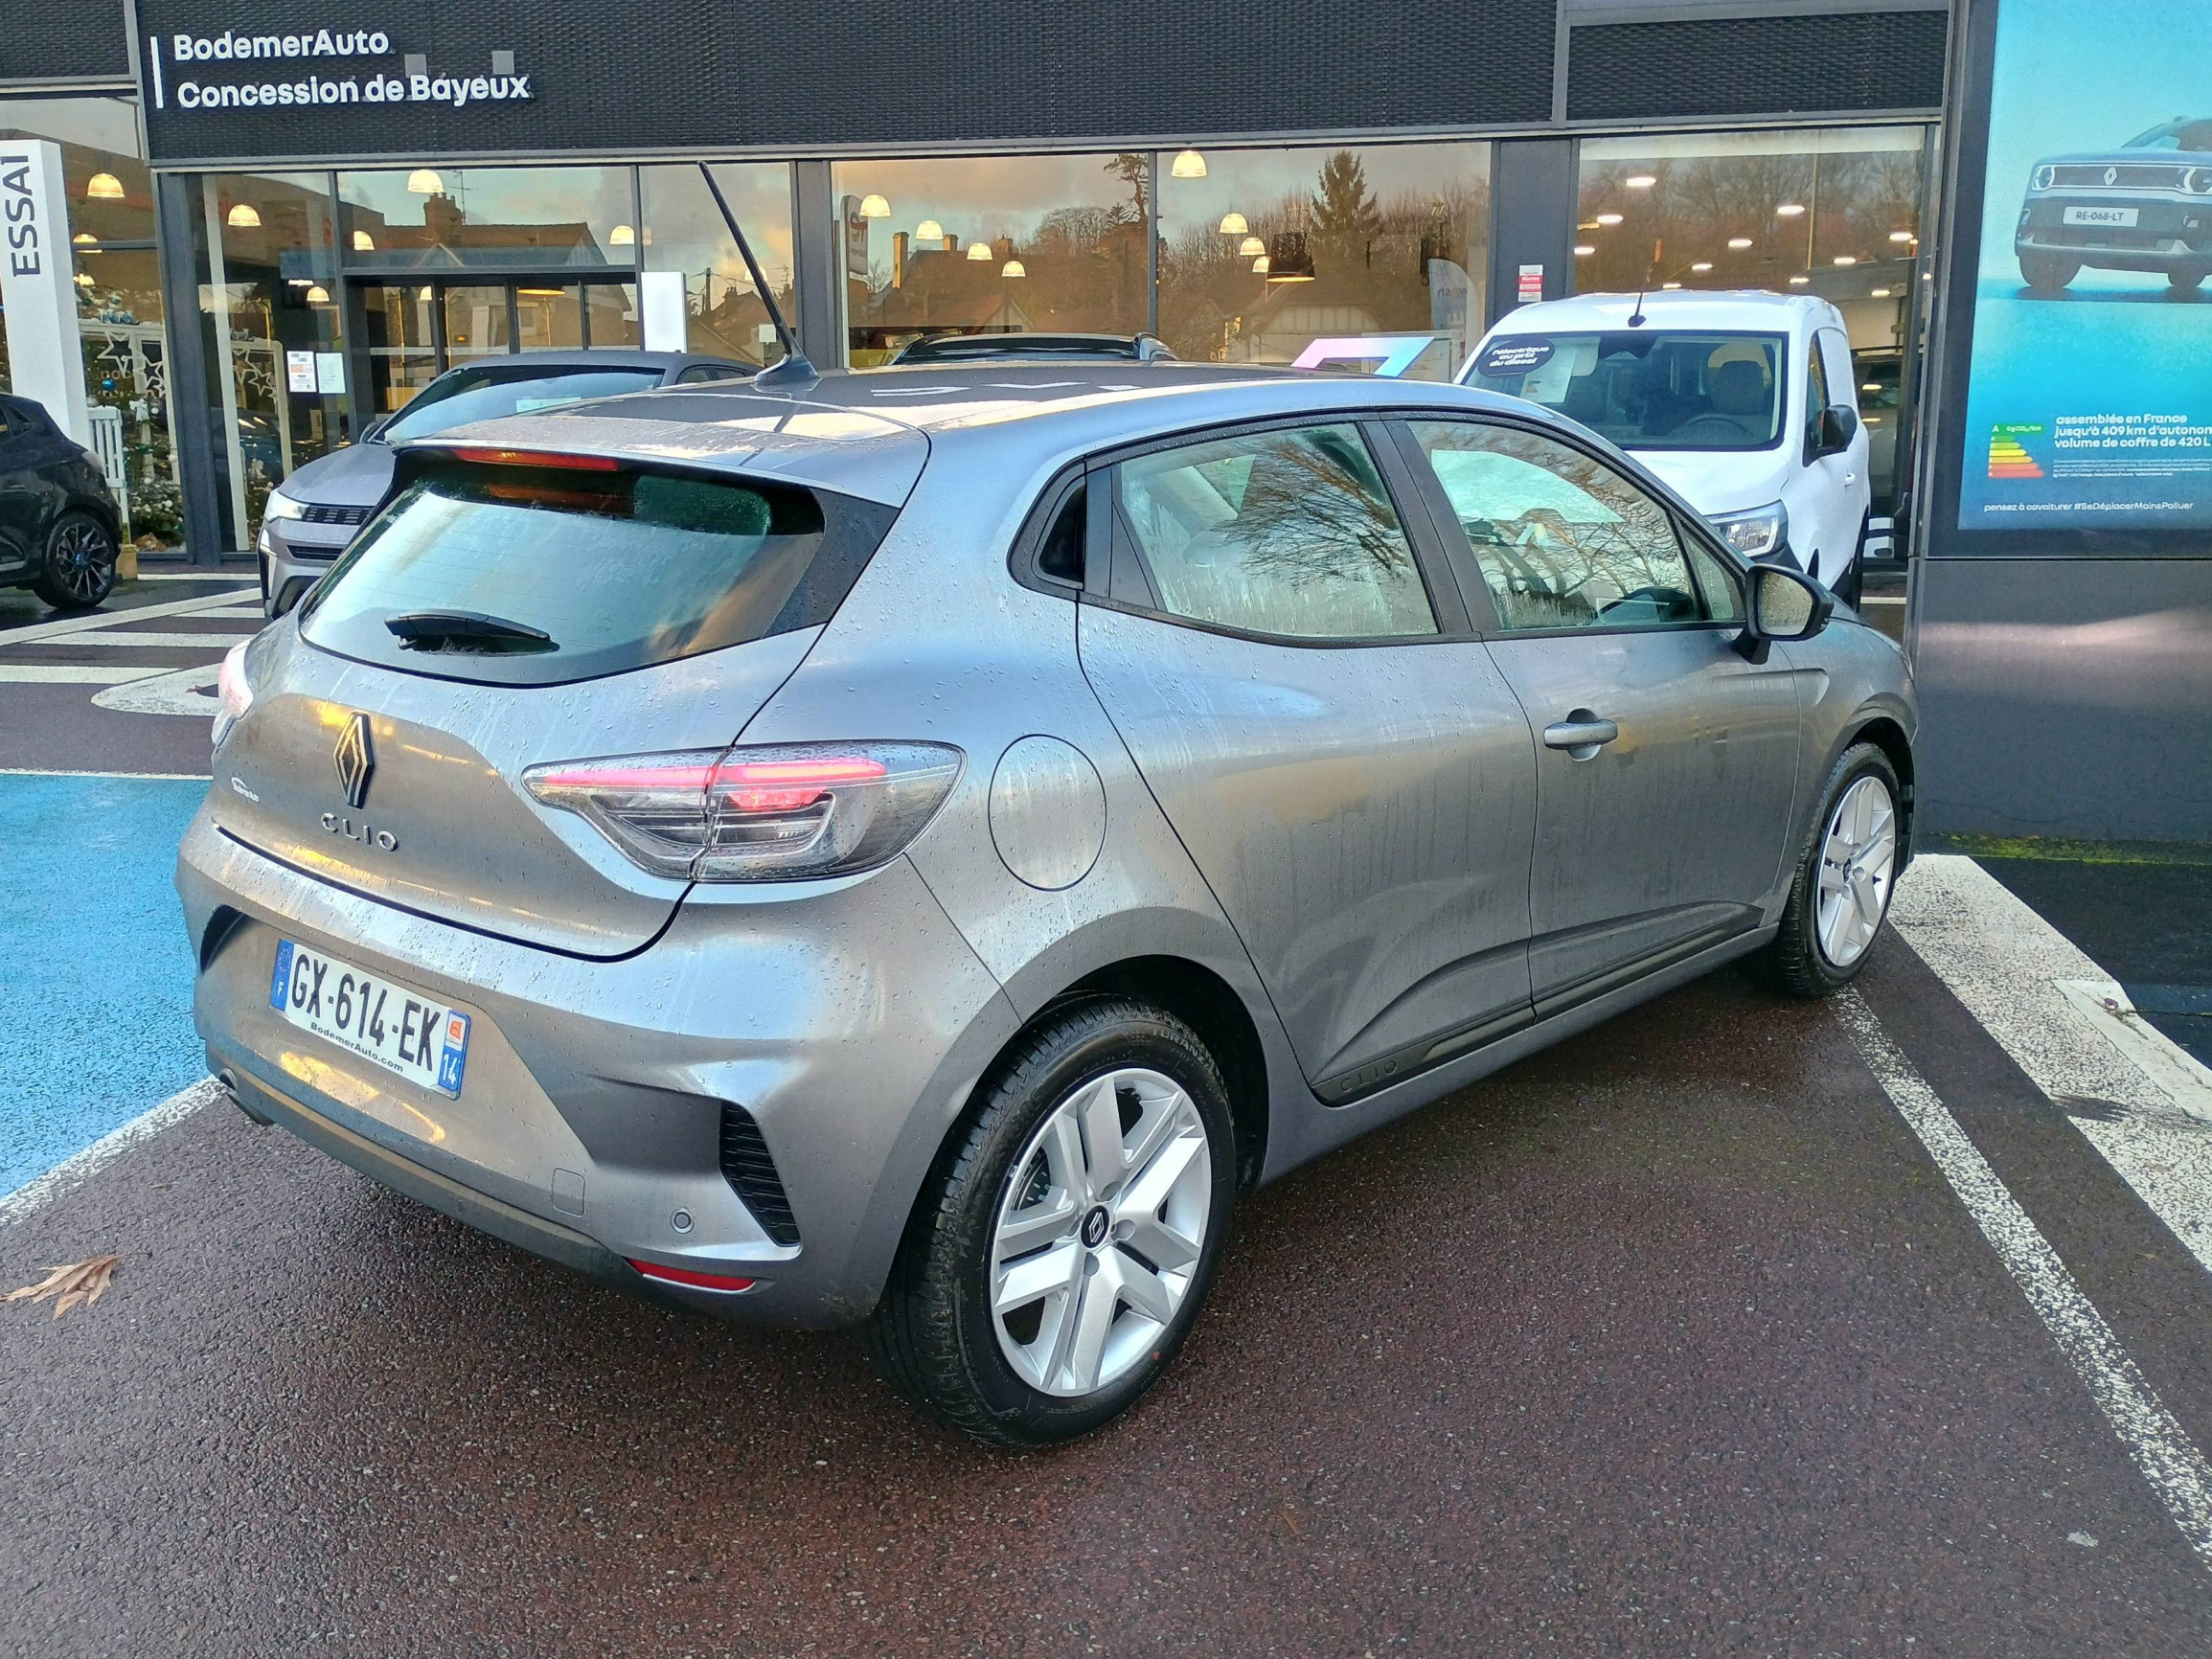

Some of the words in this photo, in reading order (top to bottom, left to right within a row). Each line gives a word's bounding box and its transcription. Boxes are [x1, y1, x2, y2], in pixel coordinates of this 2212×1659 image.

[173, 29, 389, 60] BodemerAuto
[177, 76, 359, 108] Concession
[364, 74, 404, 102] de
[410, 75, 530, 106] Bayeux
[0, 155, 40, 278] ESSAI
[2075, 211, 2125, 221] RE-068-LT
[2054, 426, 2099, 439] jusqu'à
[2101, 426, 2125, 436] 409
[2127, 425, 2146, 435] km
[2056, 414, 2124, 424] assemblée
[2125, 415, 2142, 423] en
[2143, 414, 2187, 423] France
[2054, 438, 2100, 447] volume
[2102, 438, 2118, 447] de
[2120, 437, 2158, 447] coffre
[2160, 437, 2177, 446] de
[2178, 437, 2201, 446] 420
[2203, 437, 2211, 446] L
[1984, 504, 2018, 512] pensez
[321, 812, 398, 852] CLIO
[277, 981, 285, 997] F
[291, 953, 441, 1072] GX-614-EK
[310, 1021, 403, 1073] BodemerAuto.com
[443, 1054, 457, 1084] 14
[1340, 1060, 1398, 1093] CLIO
